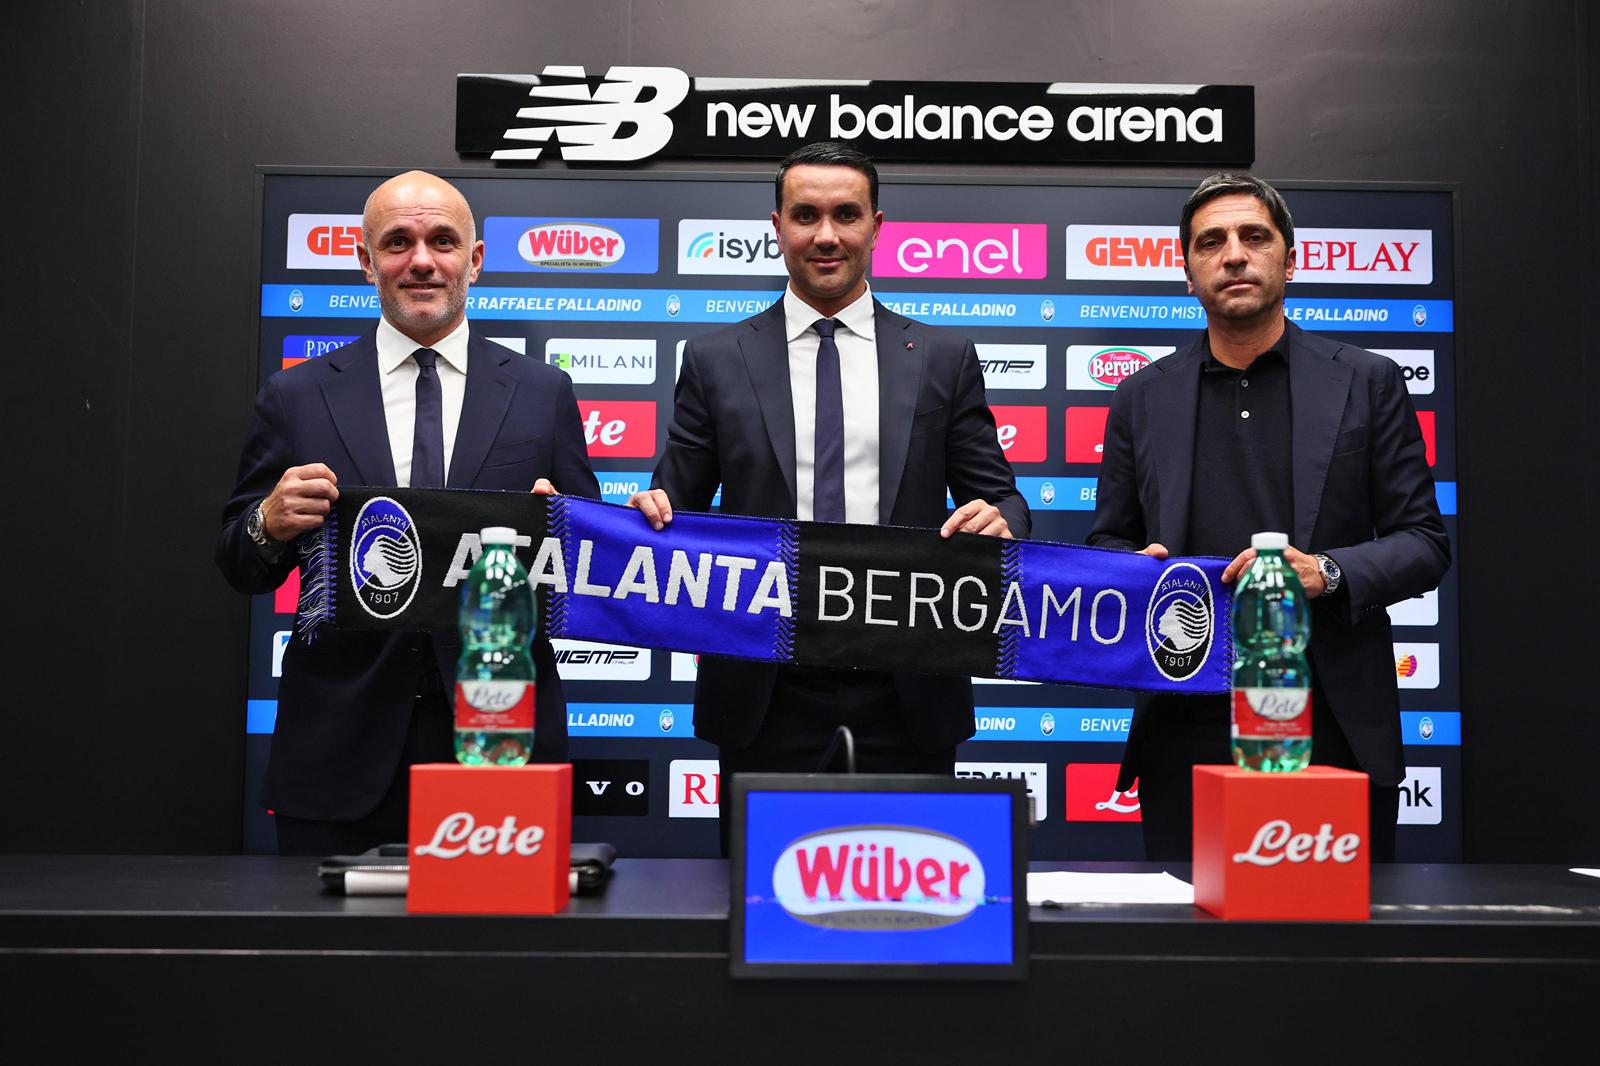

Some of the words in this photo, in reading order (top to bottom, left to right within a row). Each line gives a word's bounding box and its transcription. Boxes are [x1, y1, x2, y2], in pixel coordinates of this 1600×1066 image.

[706, 101, 817, 138] new
[830, 94, 1054, 142] balance
[1067, 106, 1223, 143] arena
[528, 230, 619, 257] Wüber
[719, 232, 784, 263] isyb
[897, 229, 1023, 275] enel
[1295, 241, 1420, 272] EPLAY
[329, 295, 381, 309] BENVE
[477, 297, 555, 311] RAFFAELE
[557, 298, 642, 312] PALLADINO
[932, 303, 1017, 317] PALLADINO
[1080, 304, 1168, 319] BENVENUTO
[1171, 306, 1207, 320] MIST
[1305, 308, 1389, 322] PALLADINO
[571, 354, 653, 369] MILANI
[361, 514, 407, 530] ATALANTA
[369, 591, 400, 604] 1907
[818, 565, 1127, 645] BERGAMO
[1164, 655, 1192, 667] 1907
[568, 713, 635, 727] LLADINO
[1081, 718, 1131, 732] BENVE
[414, 811, 545, 859] Lete
[1232, 819, 1361, 867] Lete
[796, 843, 971, 902] Wüber
